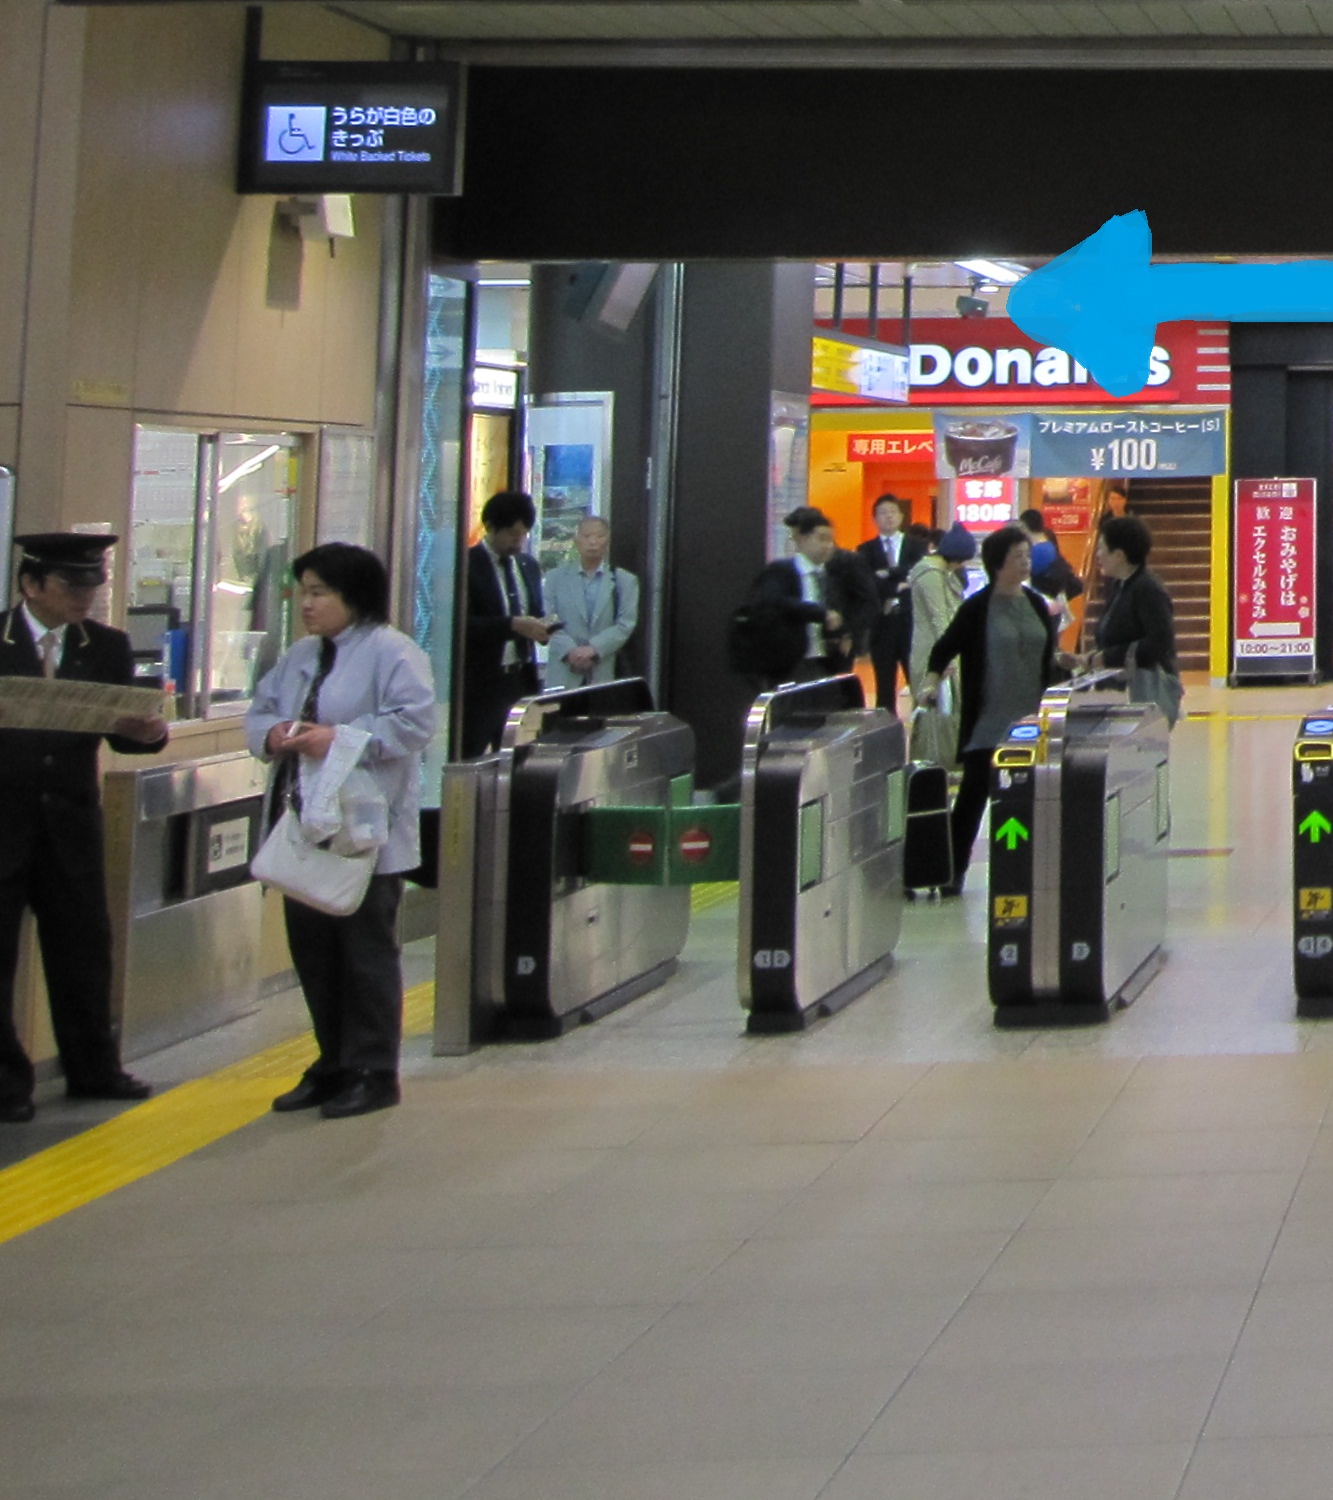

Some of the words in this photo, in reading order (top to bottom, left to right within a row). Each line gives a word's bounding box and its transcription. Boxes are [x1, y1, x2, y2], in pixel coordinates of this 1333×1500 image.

[331, 106, 437, 127] うらが白色の
[331, 129, 385, 149] きっぷ
[1090, 438, 1158, 472] ¥100
[1252, 525, 1268, 620] エクセルみなみ
[1280, 526, 1298, 606] おみやげは
